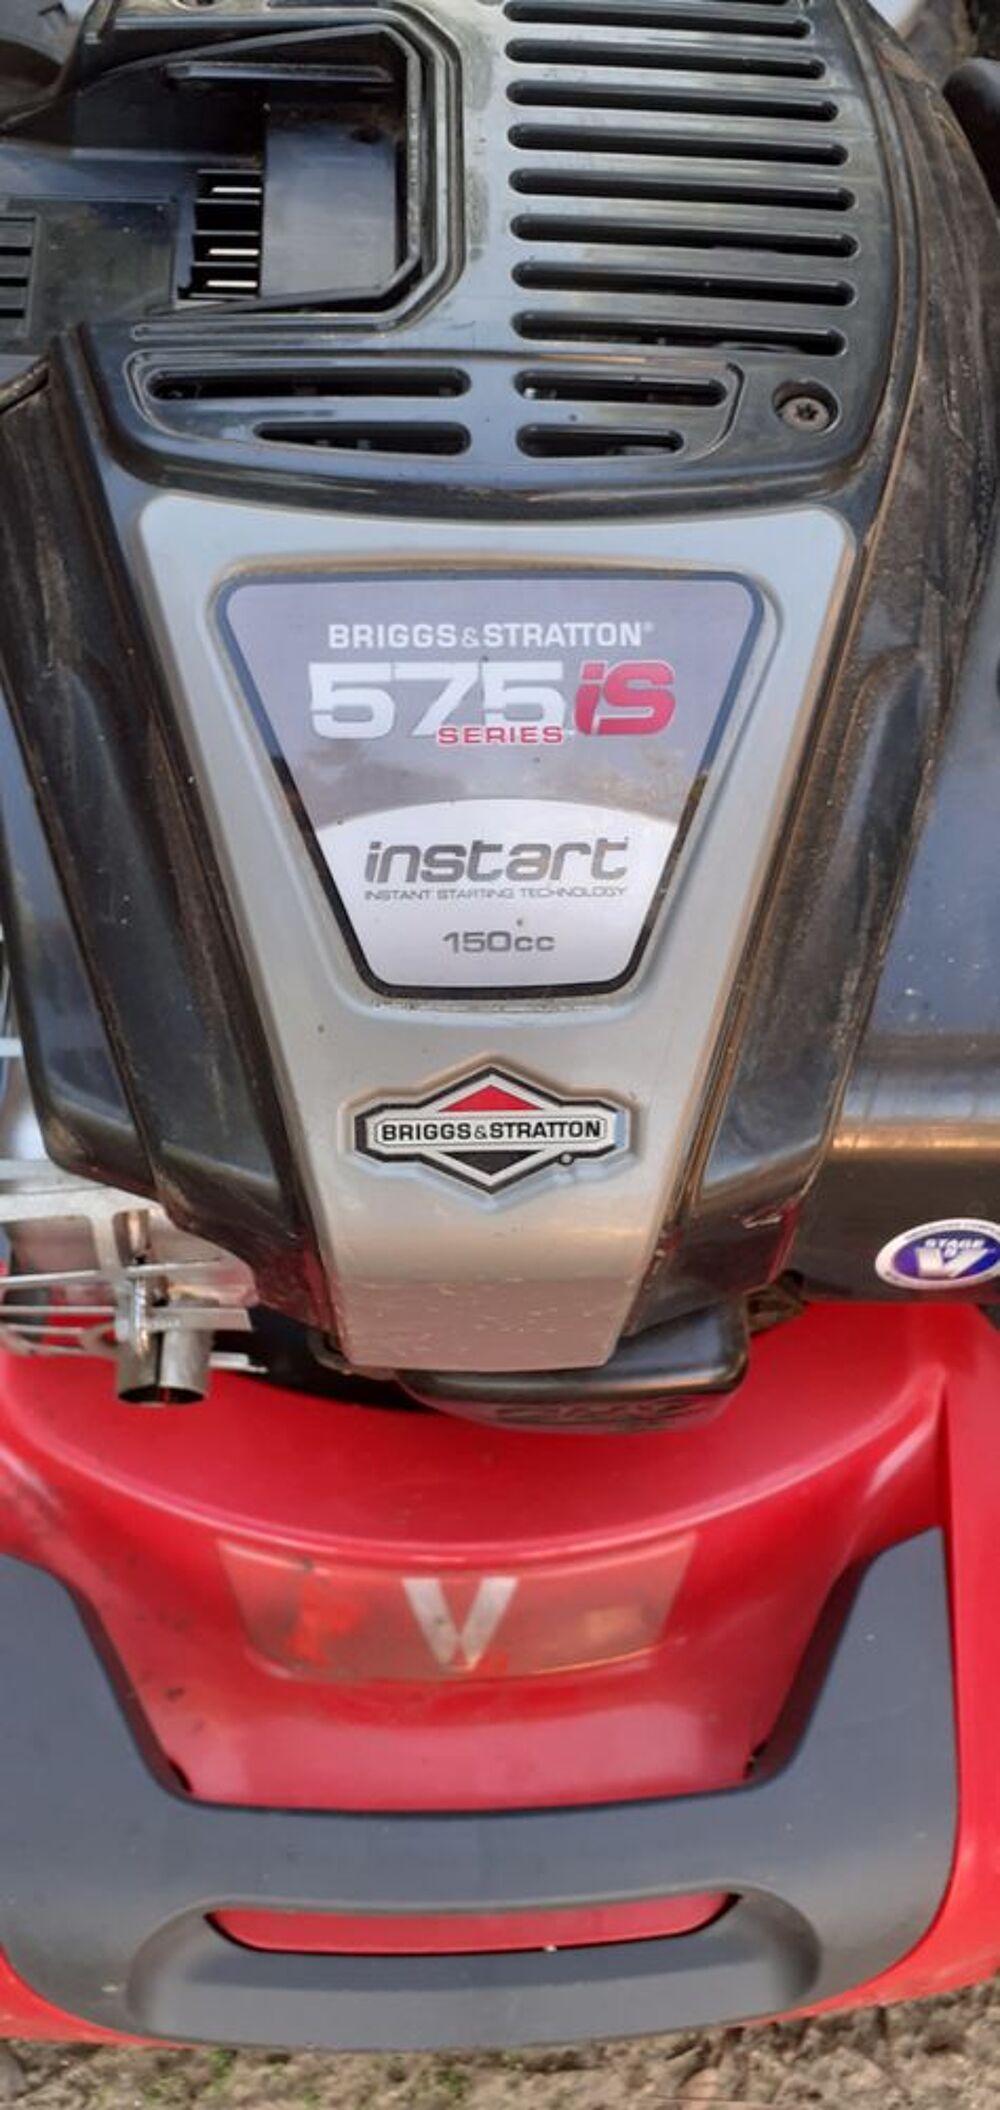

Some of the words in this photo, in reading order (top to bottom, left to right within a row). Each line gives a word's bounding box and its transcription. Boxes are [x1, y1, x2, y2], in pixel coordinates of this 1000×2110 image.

[308, 660, 568, 740] 575
[572, 659, 677, 737] iS
[437, 726, 563, 744] SERIES
[364, 838, 629, 883] instart
[365, 889, 433, 901] INSTANT
[436, 888, 514, 900] STARTING
[519, 886, 628, 898] TECHNOLOGY
[442, 931, 555, 954] 150cc
[402, 1576, 520, 1672] V
